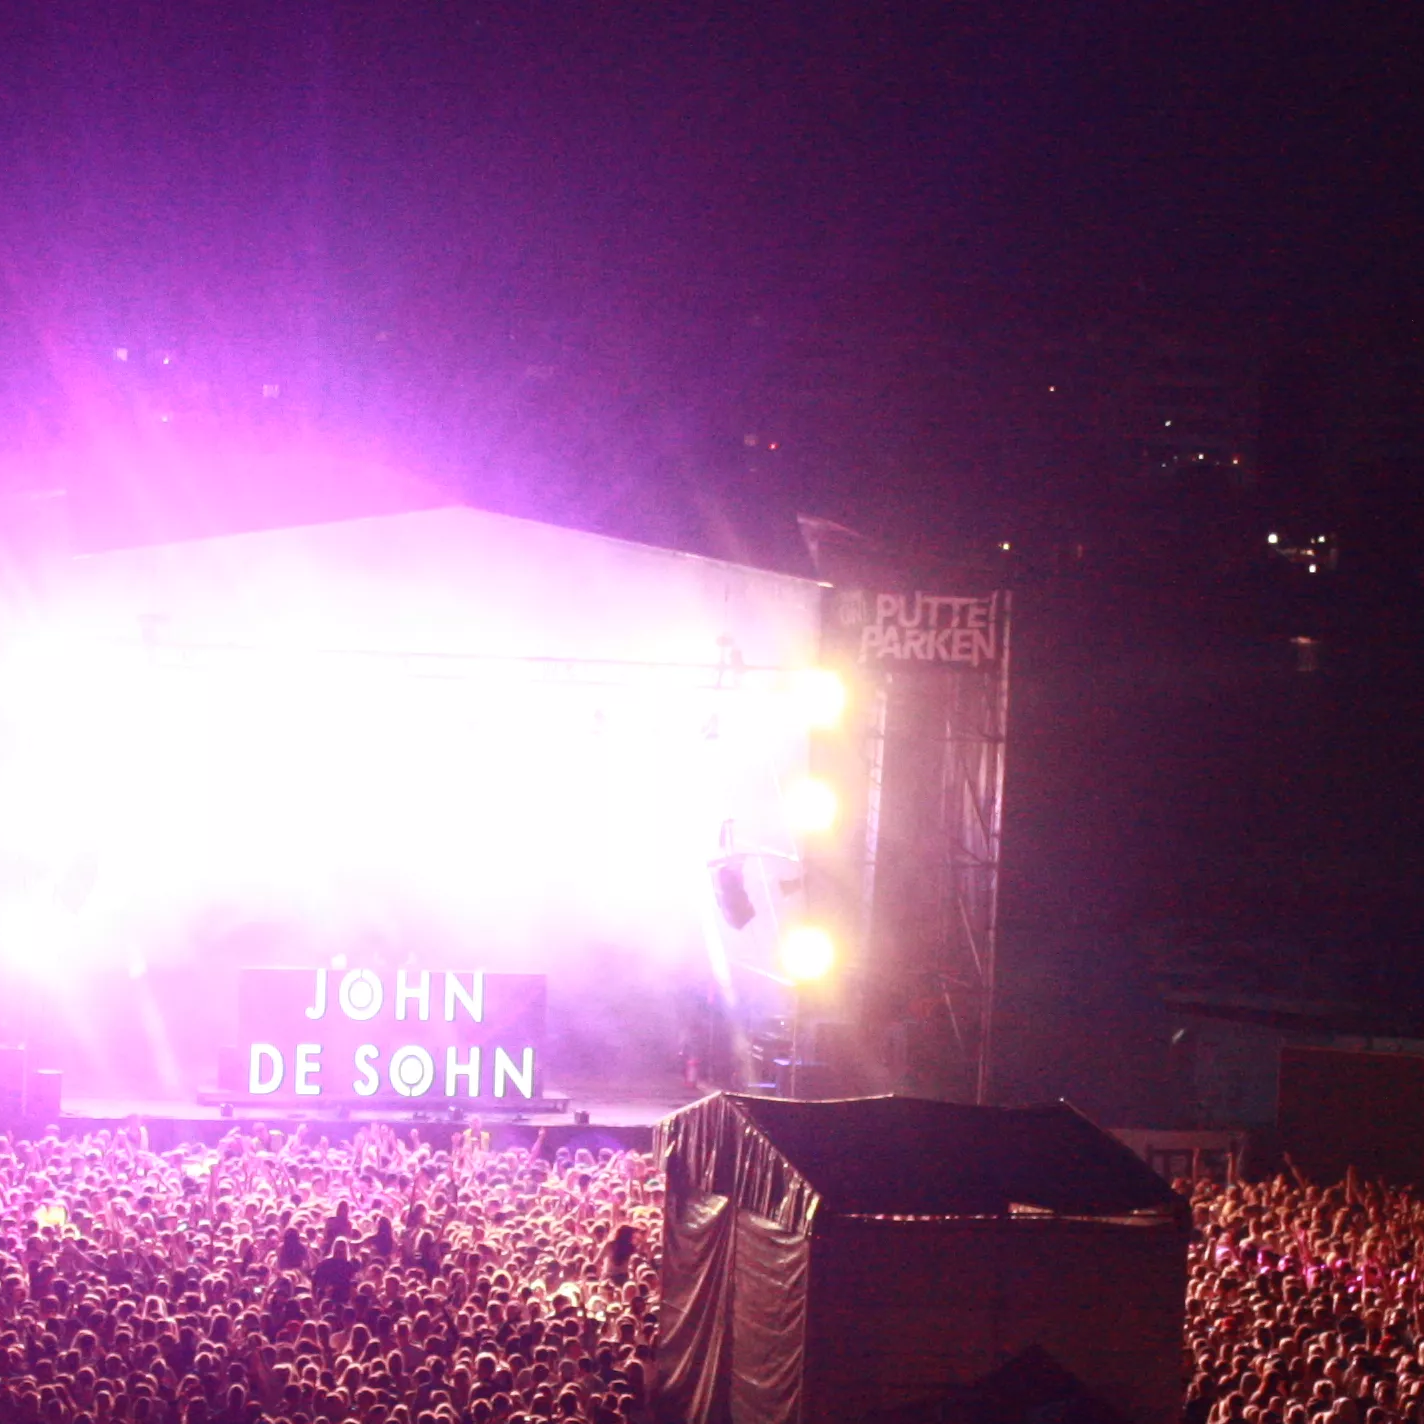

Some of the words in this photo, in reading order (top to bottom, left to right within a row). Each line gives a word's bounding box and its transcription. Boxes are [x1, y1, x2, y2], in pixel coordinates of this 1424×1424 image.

[876, 591, 989, 628] PUTTE
[857, 624, 996, 666] PARKEN
[304, 967, 486, 1023] JOHN
[248, 1043, 324, 1096] DE
[352, 1044, 536, 1099] SOHN
